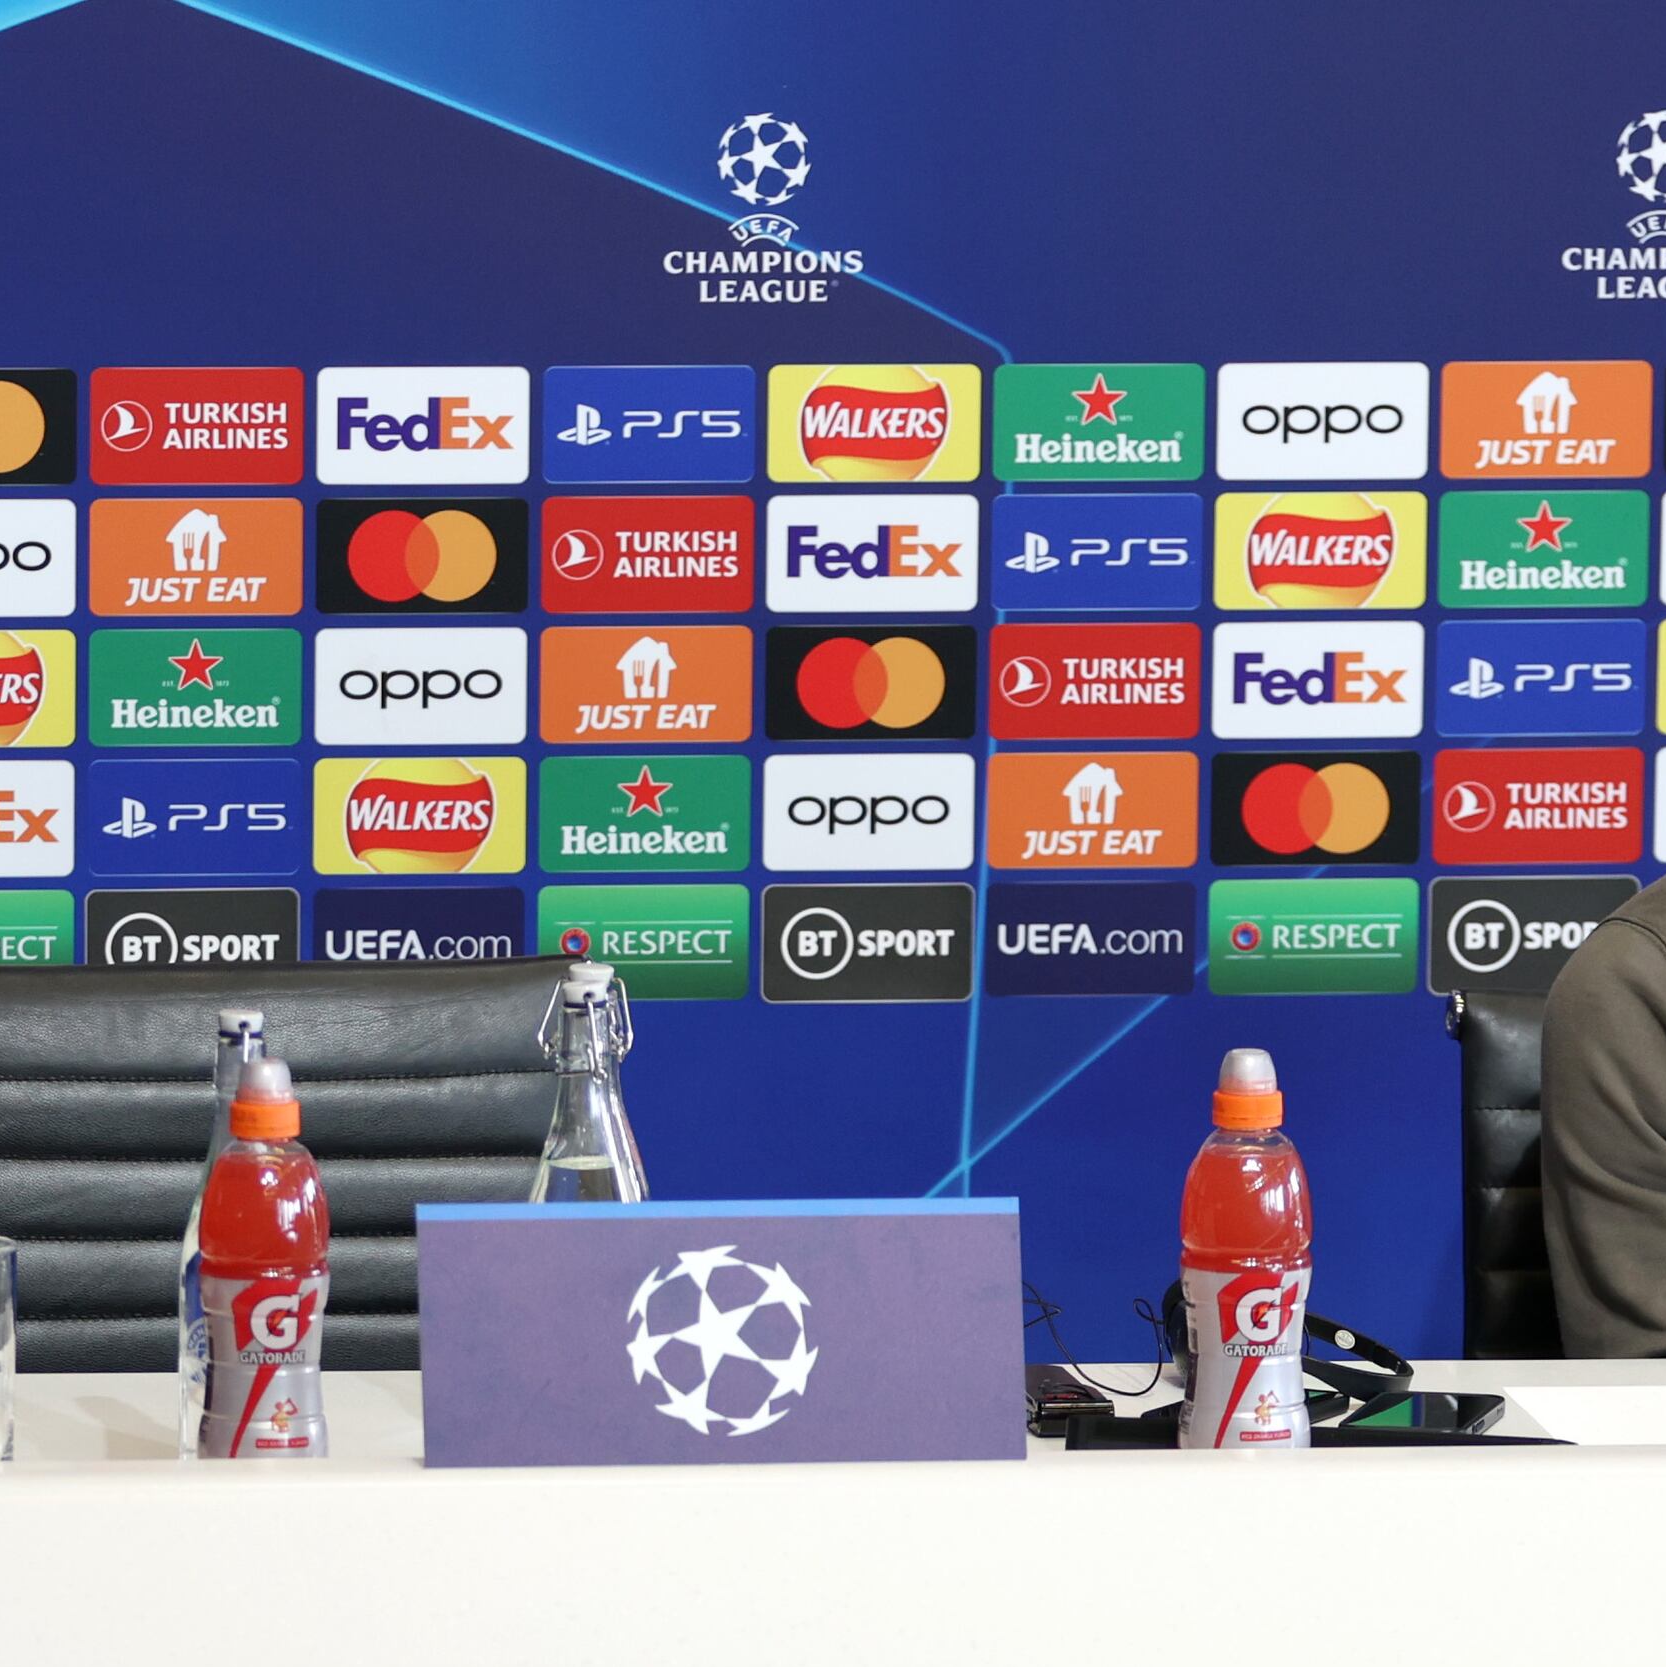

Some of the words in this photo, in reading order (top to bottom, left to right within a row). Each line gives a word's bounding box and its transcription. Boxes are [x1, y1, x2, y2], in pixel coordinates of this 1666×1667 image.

[732, 219, 793, 242] UEFA
[664, 250, 863, 273] CHAMPIONS
[700, 280, 827, 302] LEAGUE
[165, 403, 286, 423] TURKISH
[340, 397, 510, 450] FedEx
[623, 411, 740, 437] PS5
[805, 402, 944, 438] WALKERS
[1243, 405, 1402, 443] oppo
[163, 428, 288, 449] AIRLINES
[1015, 433, 1181, 463] Heineken
[1476, 440, 1551, 468] JUST
[1556, 439, 1616, 464] EAT
[616, 531, 736, 552] TURKISH
[790, 525, 959, 577] FedEx
[1071, 539, 1188, 565] PS5
[1251, 532, 1391, 567] WALKERS
[614, 556, 738, 577] AIRLINES
[1461, 560, 1625, 589] Heineken
[125, 578, 201, 606] JUST
[207, 577, 266, 601] EAT
[1063, 658, 1183, 679] TURKISH
[1236, 652, 1404, 704] FedEx
[1515, 664, 1631, 691] PS5
[340, 670, 502, 709] oppo
[1061, 683, 1184, 704] AIRLINES
[112, 699, 279, 728] Heineken
[576, 705, 651, 733] JUST
[657, 704, 716, 729] EAT
[1507, 782, 1626, 804] TURKISH
[169, 804, 286, 830] PS5
[351, 795, 490, 830] WALKERS
[788, 796, 949, 834] oppo
[1505, 807, 1627, 829] AIRLINES
[561, 825, 727, 854] Heineken
[1022, 830, 1097, 859] JUST
[1103, 830, 1162, 854] EAT
[123, 936, 161, 961] BT
[183, 935, 279, 961] SPORT
[326, 930, 511, 960] UEFA.com
[603, 930, 731, 954] RESPECT
[799, 931, 837, 956] BT
[858, 930, 954, 956] SPORT
[999, 924, 1182, 954] UEFA.com
[1273, 924, 1401, 949] RESPECT
[1465, 923, 1504, 949] BT
[1523, 921, 1599, 949] SPO
[251, 1294, 301, 1349] G
[1235, 1287, 1283, 1342] G
